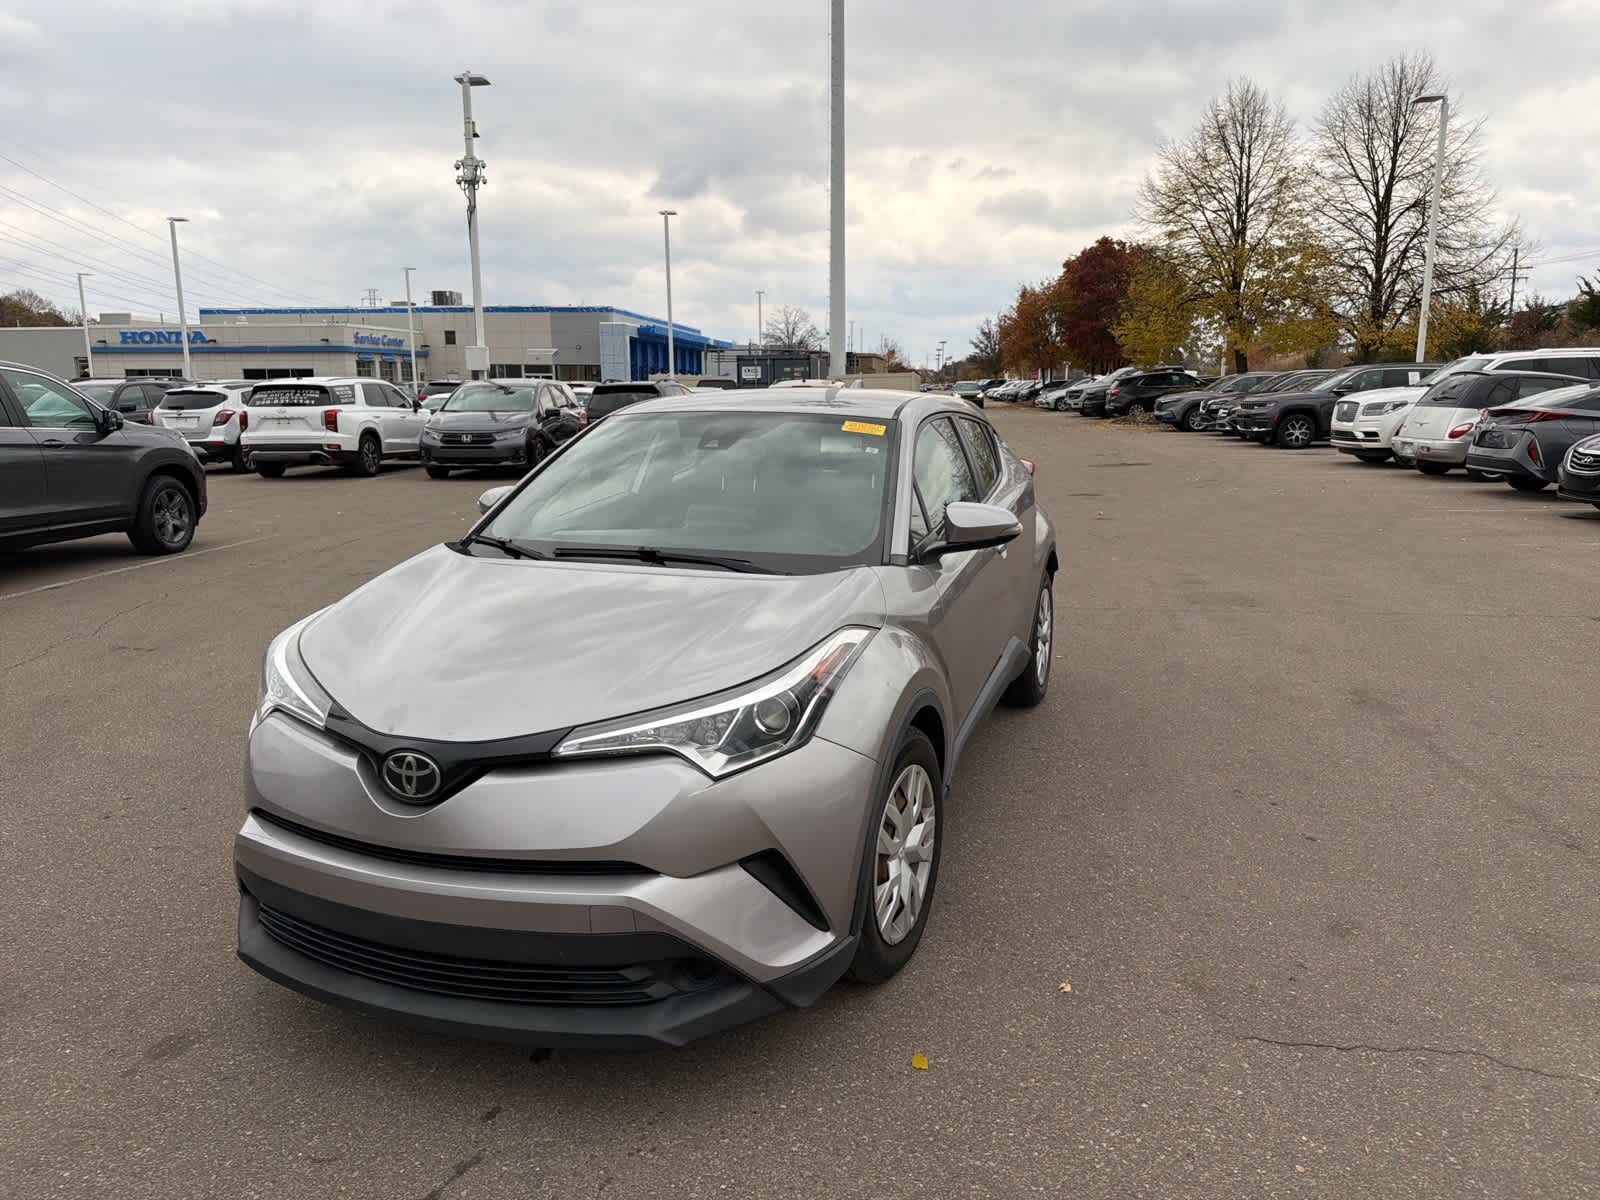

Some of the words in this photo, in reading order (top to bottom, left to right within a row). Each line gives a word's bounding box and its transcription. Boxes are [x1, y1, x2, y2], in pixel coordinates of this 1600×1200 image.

[119, 331, 207, 345] HONDA
[353, 331, 380, 345] Service
[381, 334, 405, 347] Center
